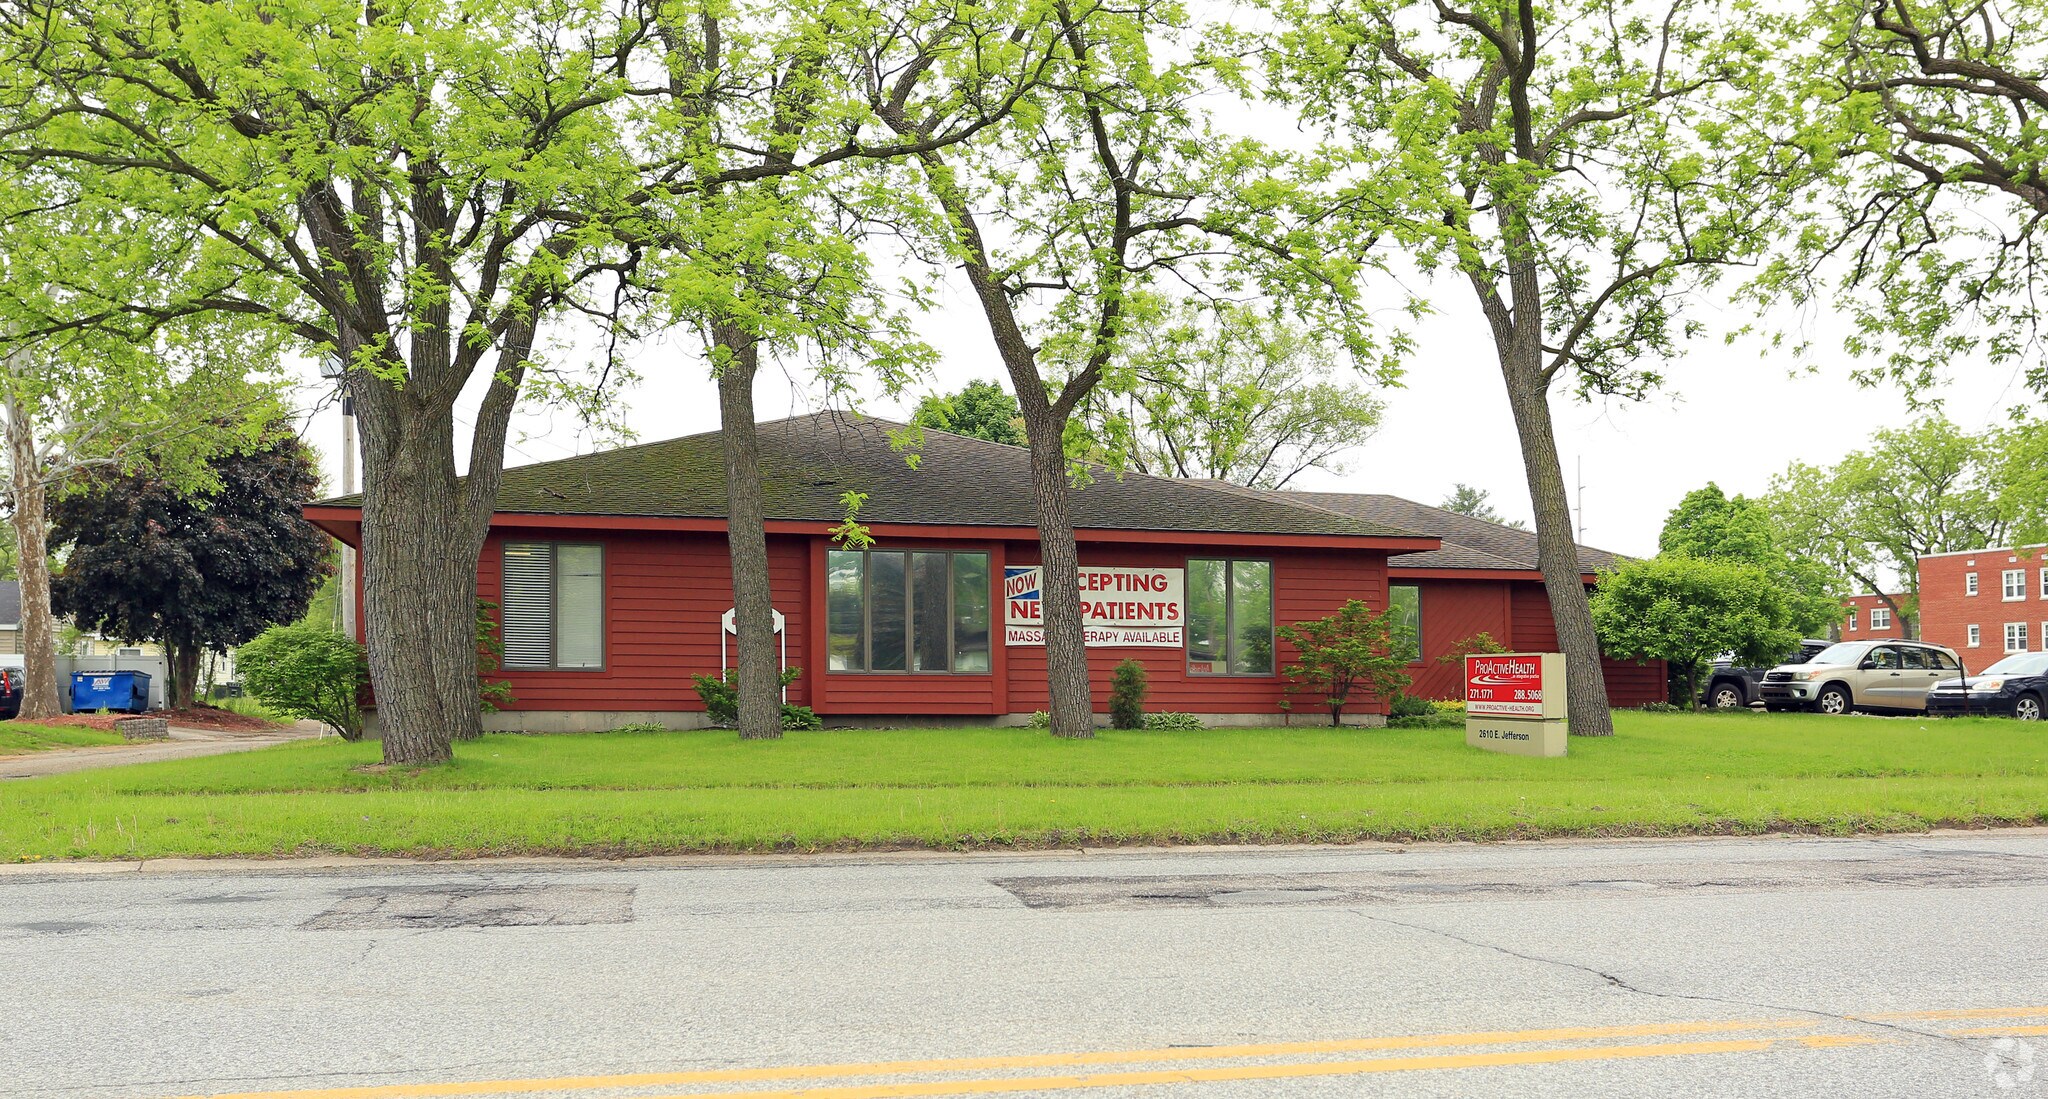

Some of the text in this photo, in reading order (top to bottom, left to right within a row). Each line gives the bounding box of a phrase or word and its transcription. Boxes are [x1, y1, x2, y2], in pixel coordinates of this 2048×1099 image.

[1006, 573, 1037, 597] NOW
[1078, 573, 1168, 592] CEPTING
[1011, 600, 1179, 620] NE PATIENTS
[1008, 630, 1180, 643] MASS ERAPY AVAILABLE
[1470, 689, 1493, 699] 271.1771
[1514, 690, 1542, 700] 288.5068
[1479, 729, 1530, 740] 2610 E. Jefferson
